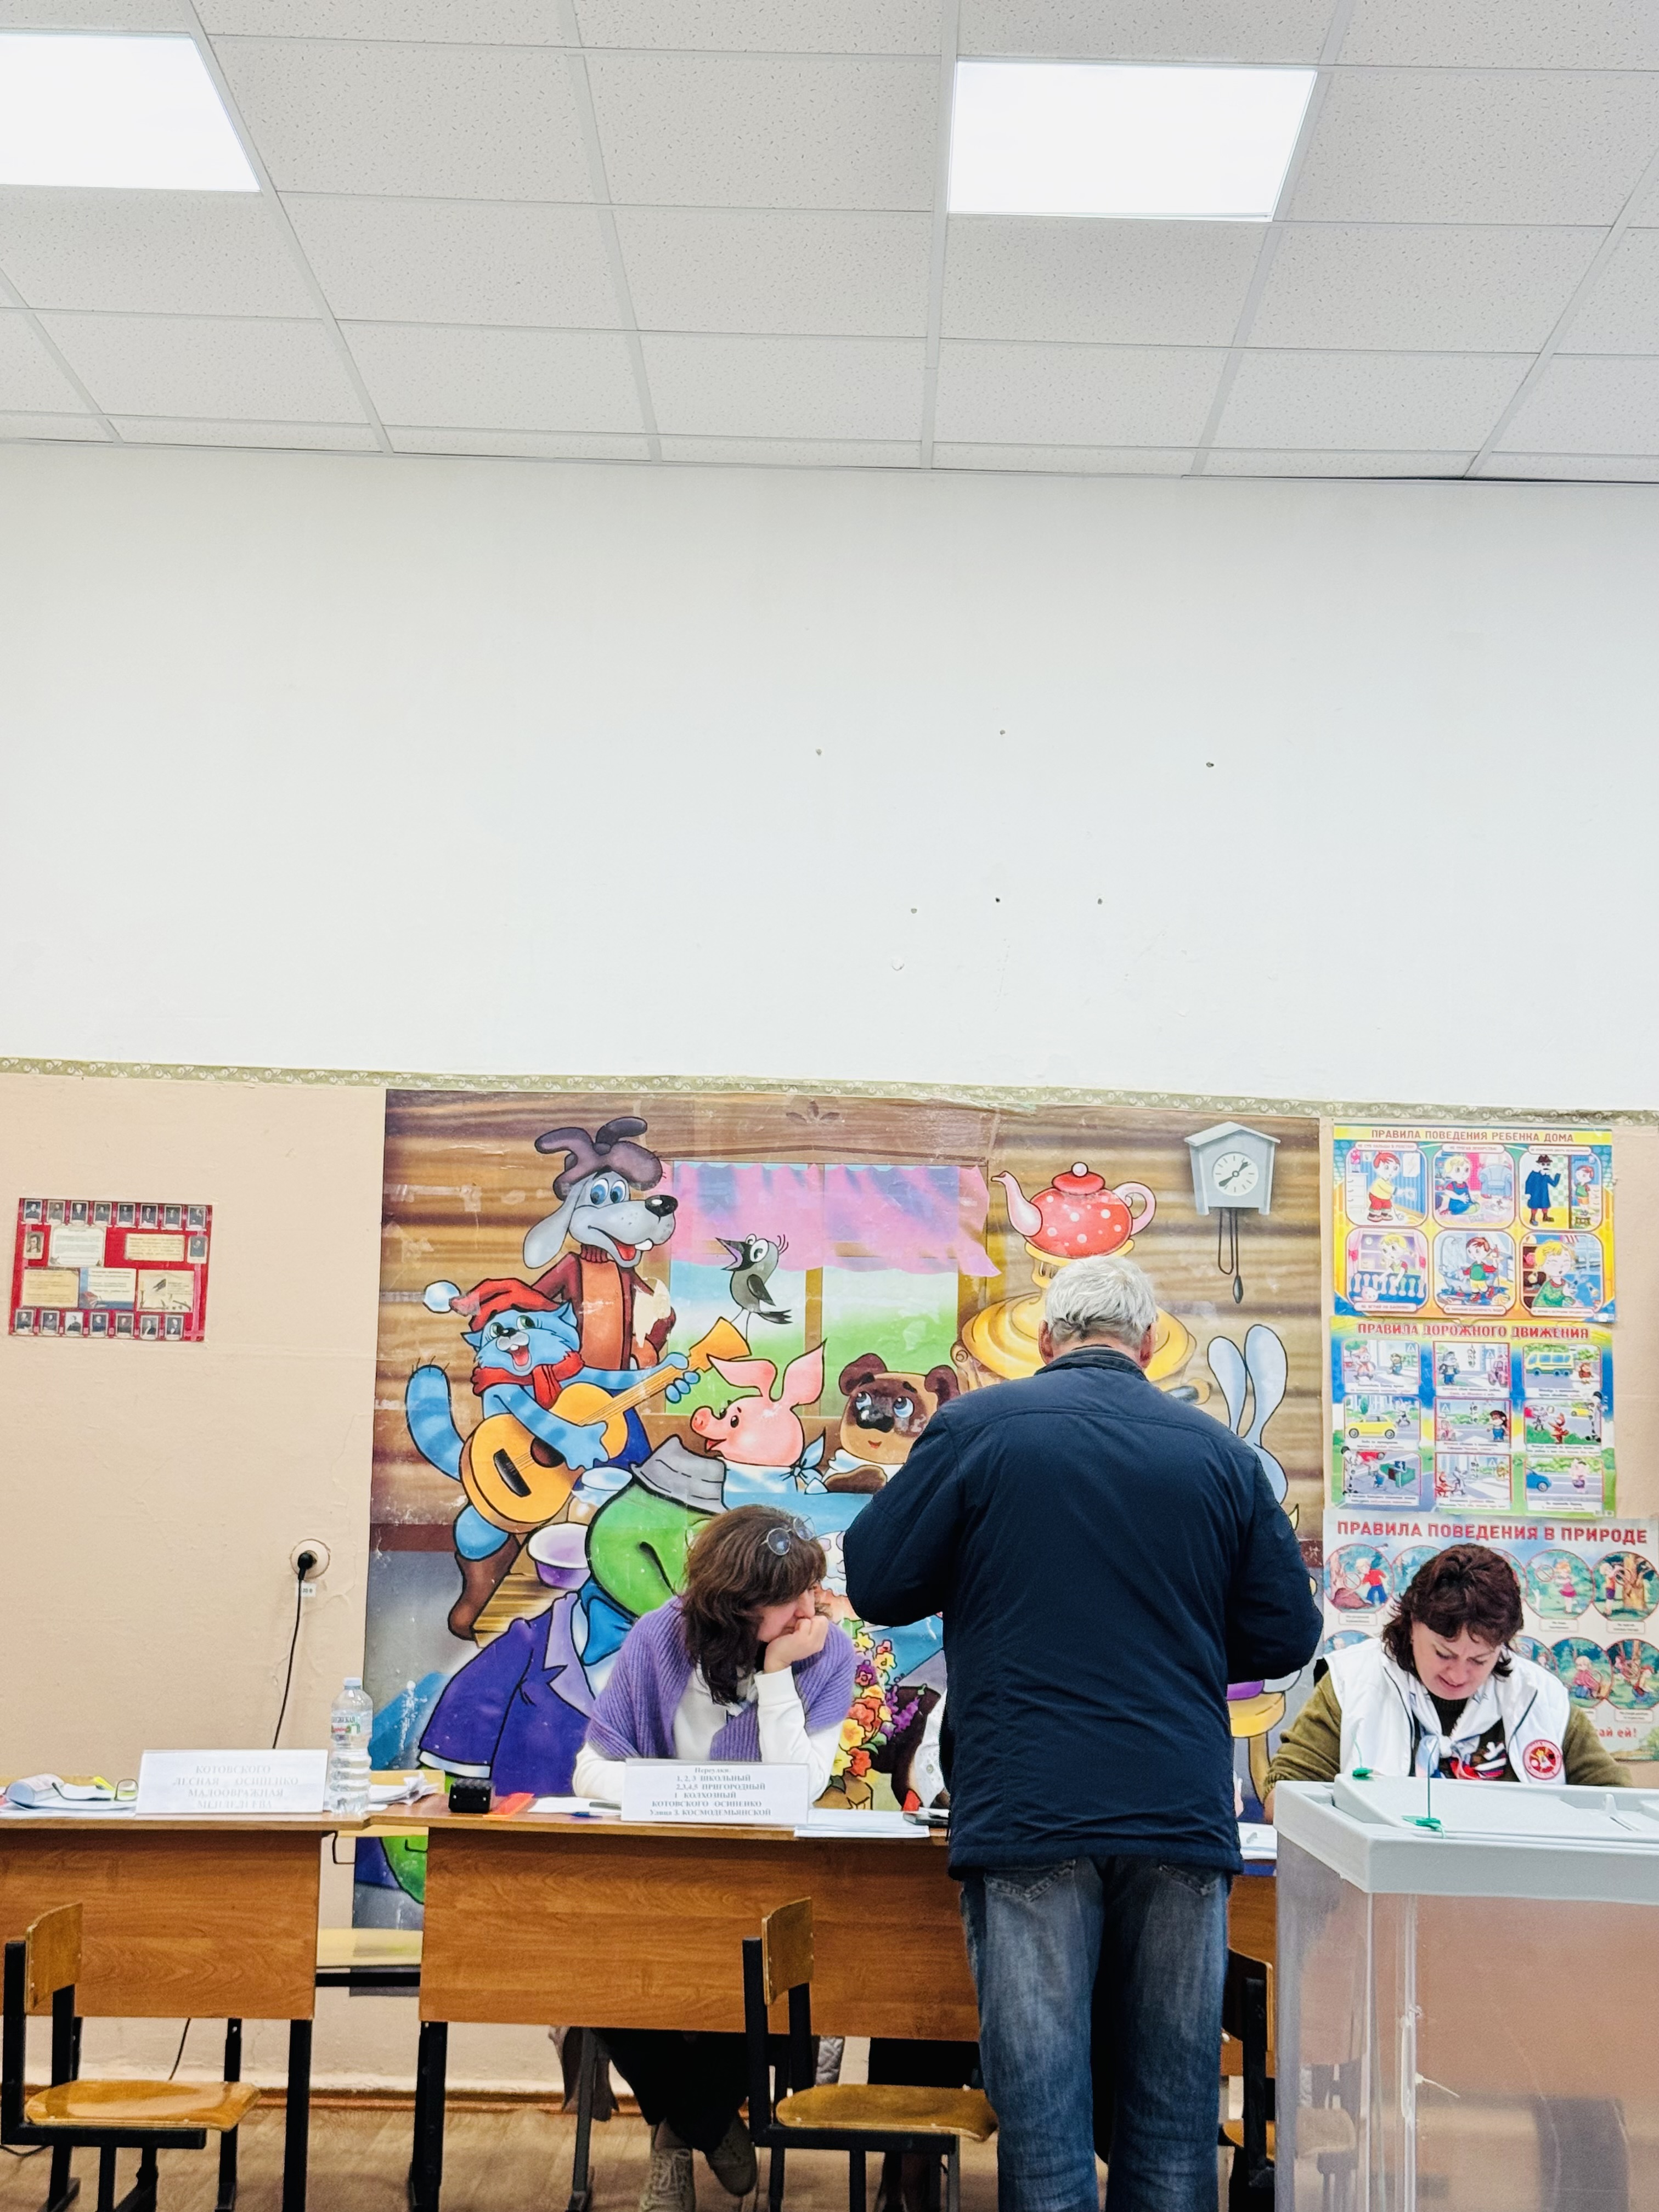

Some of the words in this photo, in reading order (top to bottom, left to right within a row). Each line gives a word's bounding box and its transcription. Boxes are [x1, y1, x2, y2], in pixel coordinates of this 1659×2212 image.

[1372, 1130, 1420, 1139] ПРАВИЛА
[1426, 1130, 1487, 1141] ПОВЕДЕНИЯ
[1544, 1133, 1574, 1142] ДОМА
[1358, 1323, 1419, 1335] ПРАВИЛА
[1423, 1324, 1507, 1337] ДОРОЖНОГО
[1511, 1327, 1589, 1339] ДВИЖЕНИЯ
[1338, 1521, 1423, 1537] ПРАВИЛА
[1428, 1523, 1538, 1541] ПОВЕДЕНИЯ
[1544, 1526, 1555, 1541] В
[1561, 1527, 1647, 1545] ПРИРОДЕ
[1617, 1727, 1637, 1738] ей!
[195, 1765, 271, 1774] КОТОВСКОГО
